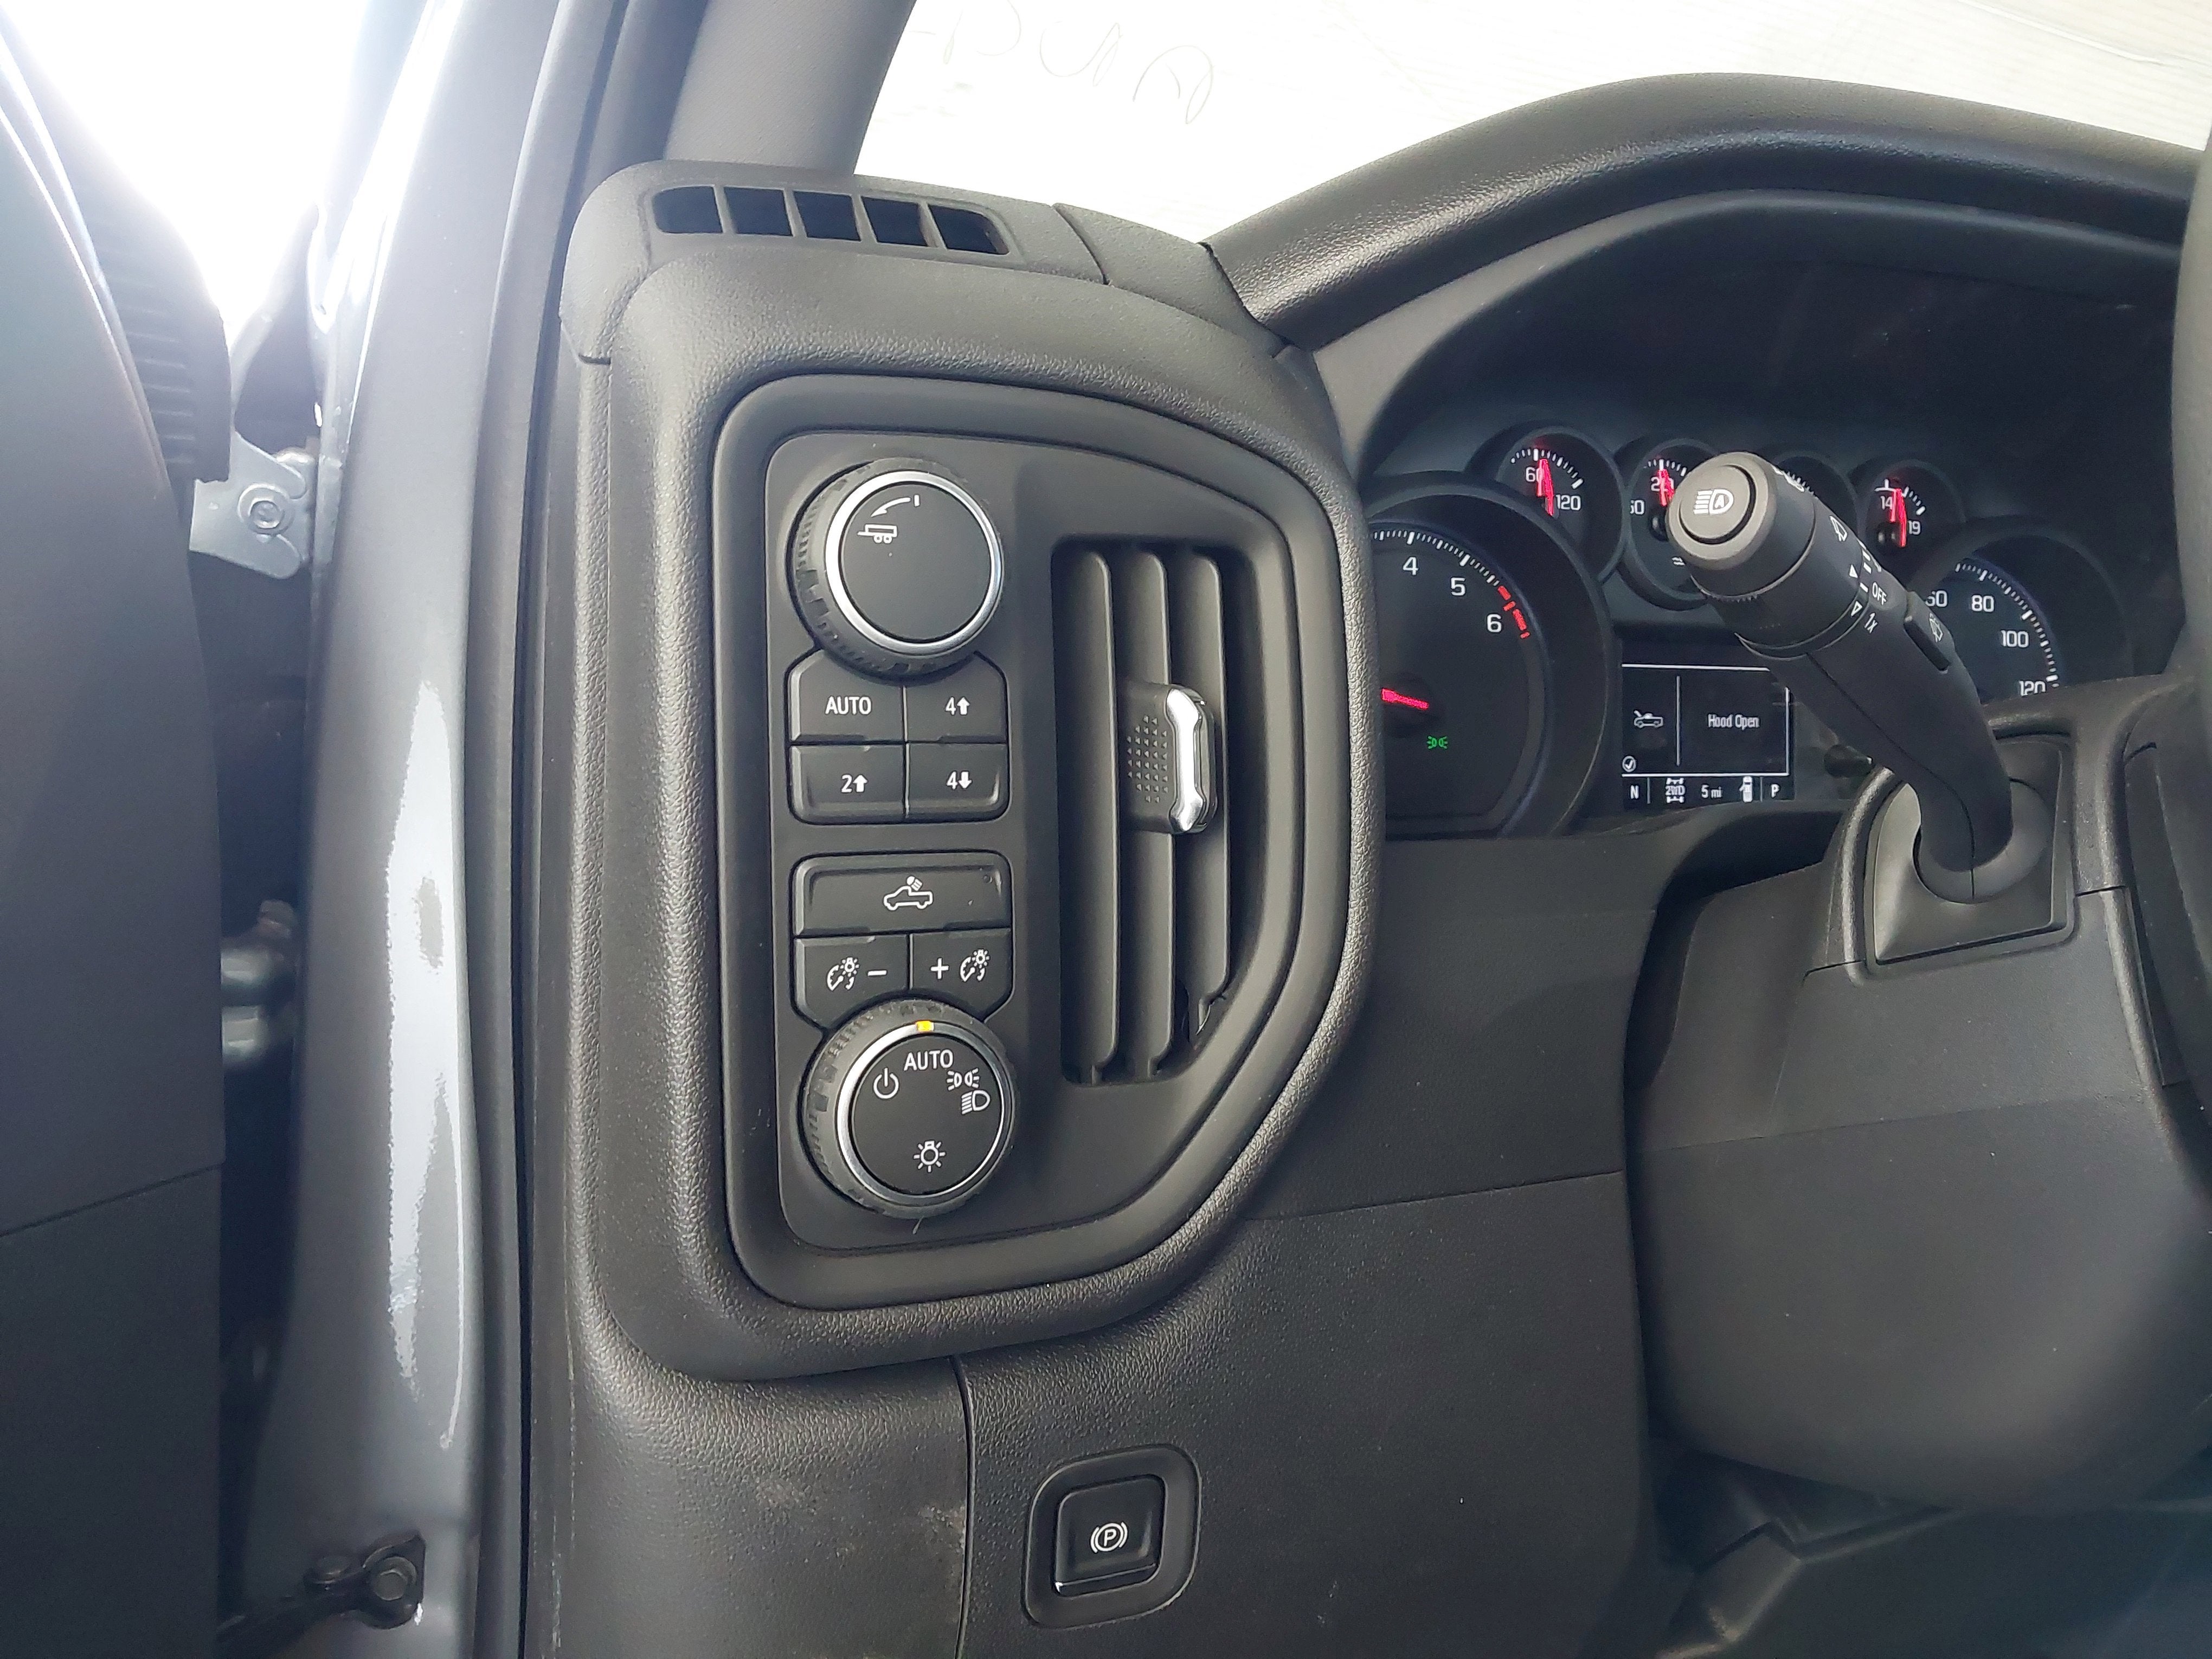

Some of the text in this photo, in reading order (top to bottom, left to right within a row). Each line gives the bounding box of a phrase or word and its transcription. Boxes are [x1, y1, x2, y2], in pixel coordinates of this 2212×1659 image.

[1555, 494, 1581, 511] 120
[1880, 495, 1893, 510] 14
[1908, 520, 1921, 535] 19
[1403, 556, 1419, 575] 4
[1450, 577, 1466, 596] 5
[1872, 581, 1887, 606] OFF
[1971, 595, 1995, 612] 80
[1486, 614, 1502, 633] 6
[2001, 630, 2029, 648] 100
[825, 696, 871, 715] AUTO
[1708, 713, 1760, 730] Hood Open
[1630, 785, 1639, 800] N
[1665, 786, 1686, 796] 2WD
[1701, 784, 1722, 799] 5 mi
[1771, 783, 1780, 798] P
[903, 1049, 954, 1071] AUTO
[1103, 1528, 1117, 1547] P
